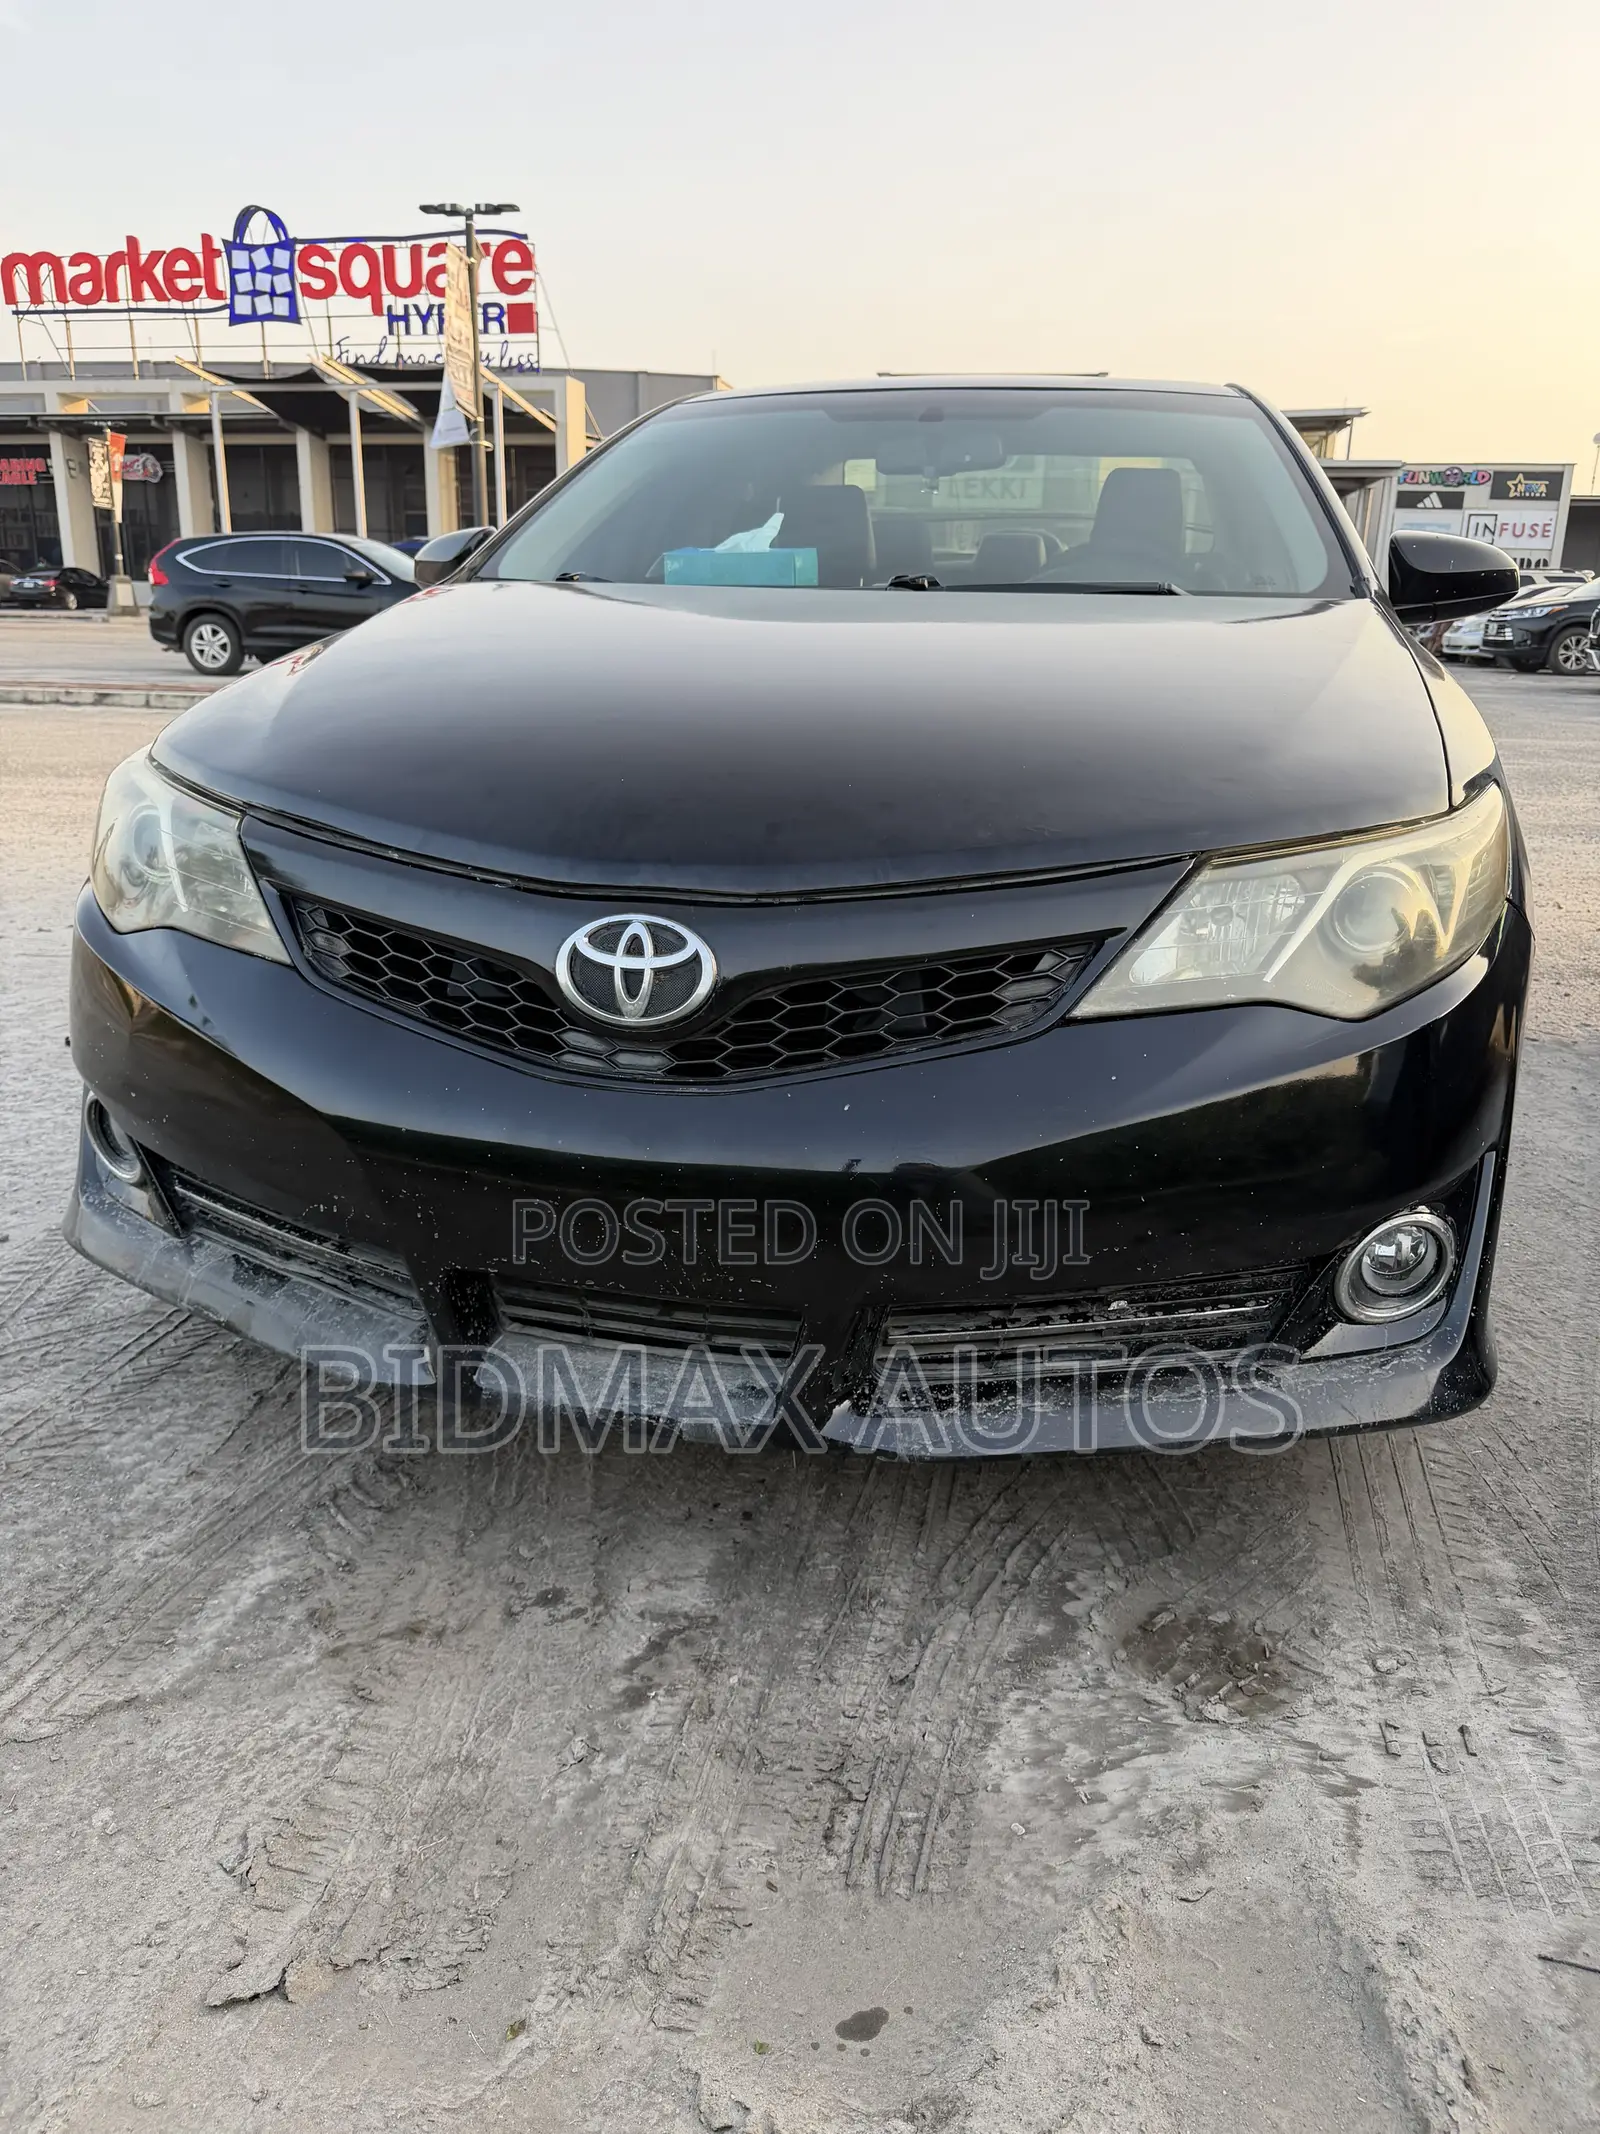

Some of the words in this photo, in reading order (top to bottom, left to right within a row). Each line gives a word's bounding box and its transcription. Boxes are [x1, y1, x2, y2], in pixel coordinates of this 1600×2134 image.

[1, 232, 228, 306] market
[387, 302, 506, 335] HYR
[948, 477, 1026, 499] LEKKI
